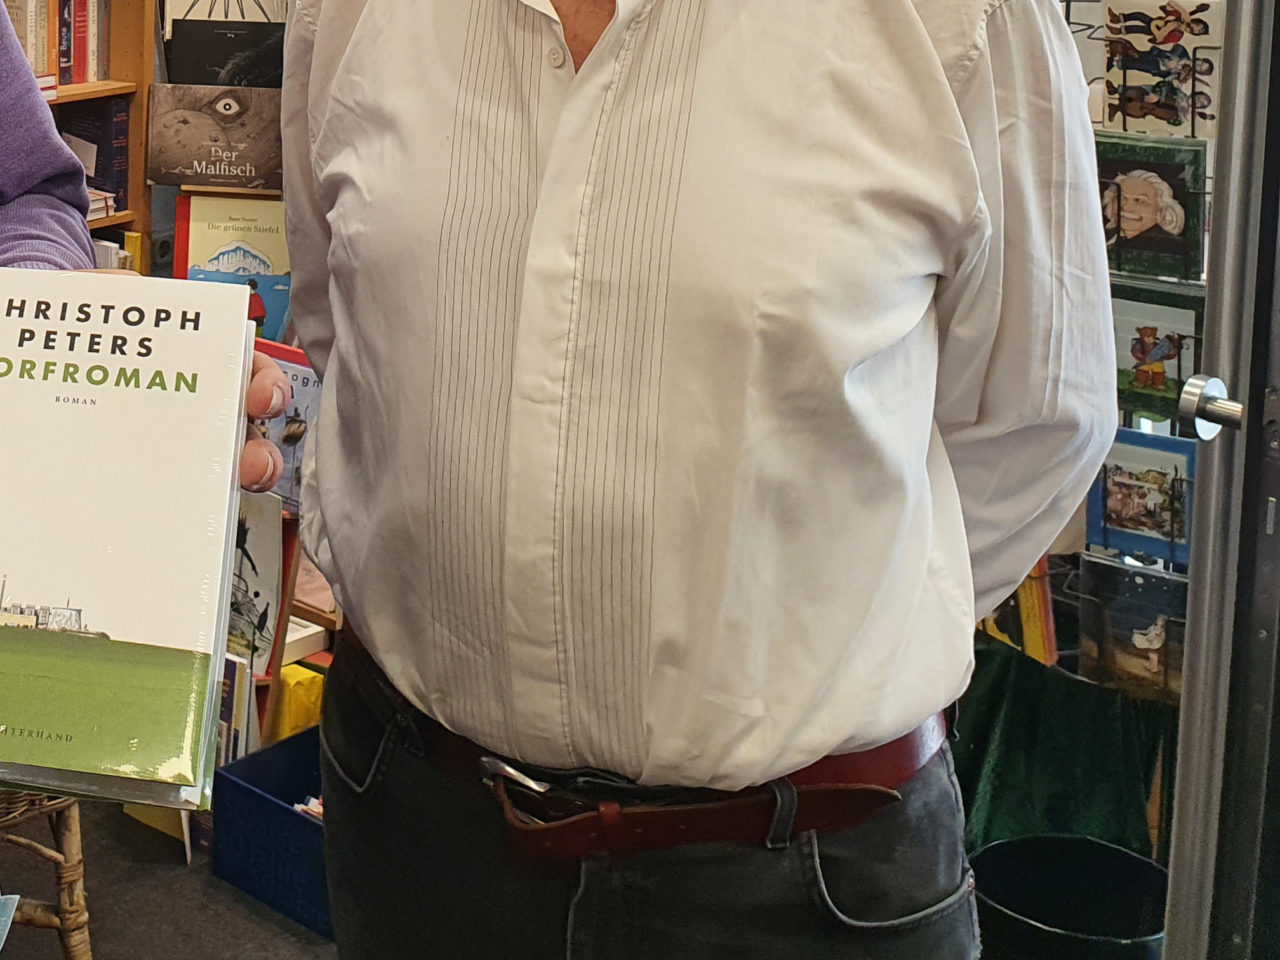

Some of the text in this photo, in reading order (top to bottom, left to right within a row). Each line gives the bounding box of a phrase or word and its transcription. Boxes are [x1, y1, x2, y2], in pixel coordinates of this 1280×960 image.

[211, 147, 239, 161] Der
[193, 160, 256, 177] Malfisch
[207, 222, 280, 234] Die grünen Stiefel
[18, 328, 154, 358] PETERS
[55, 396, 97, 407] ROMAN
